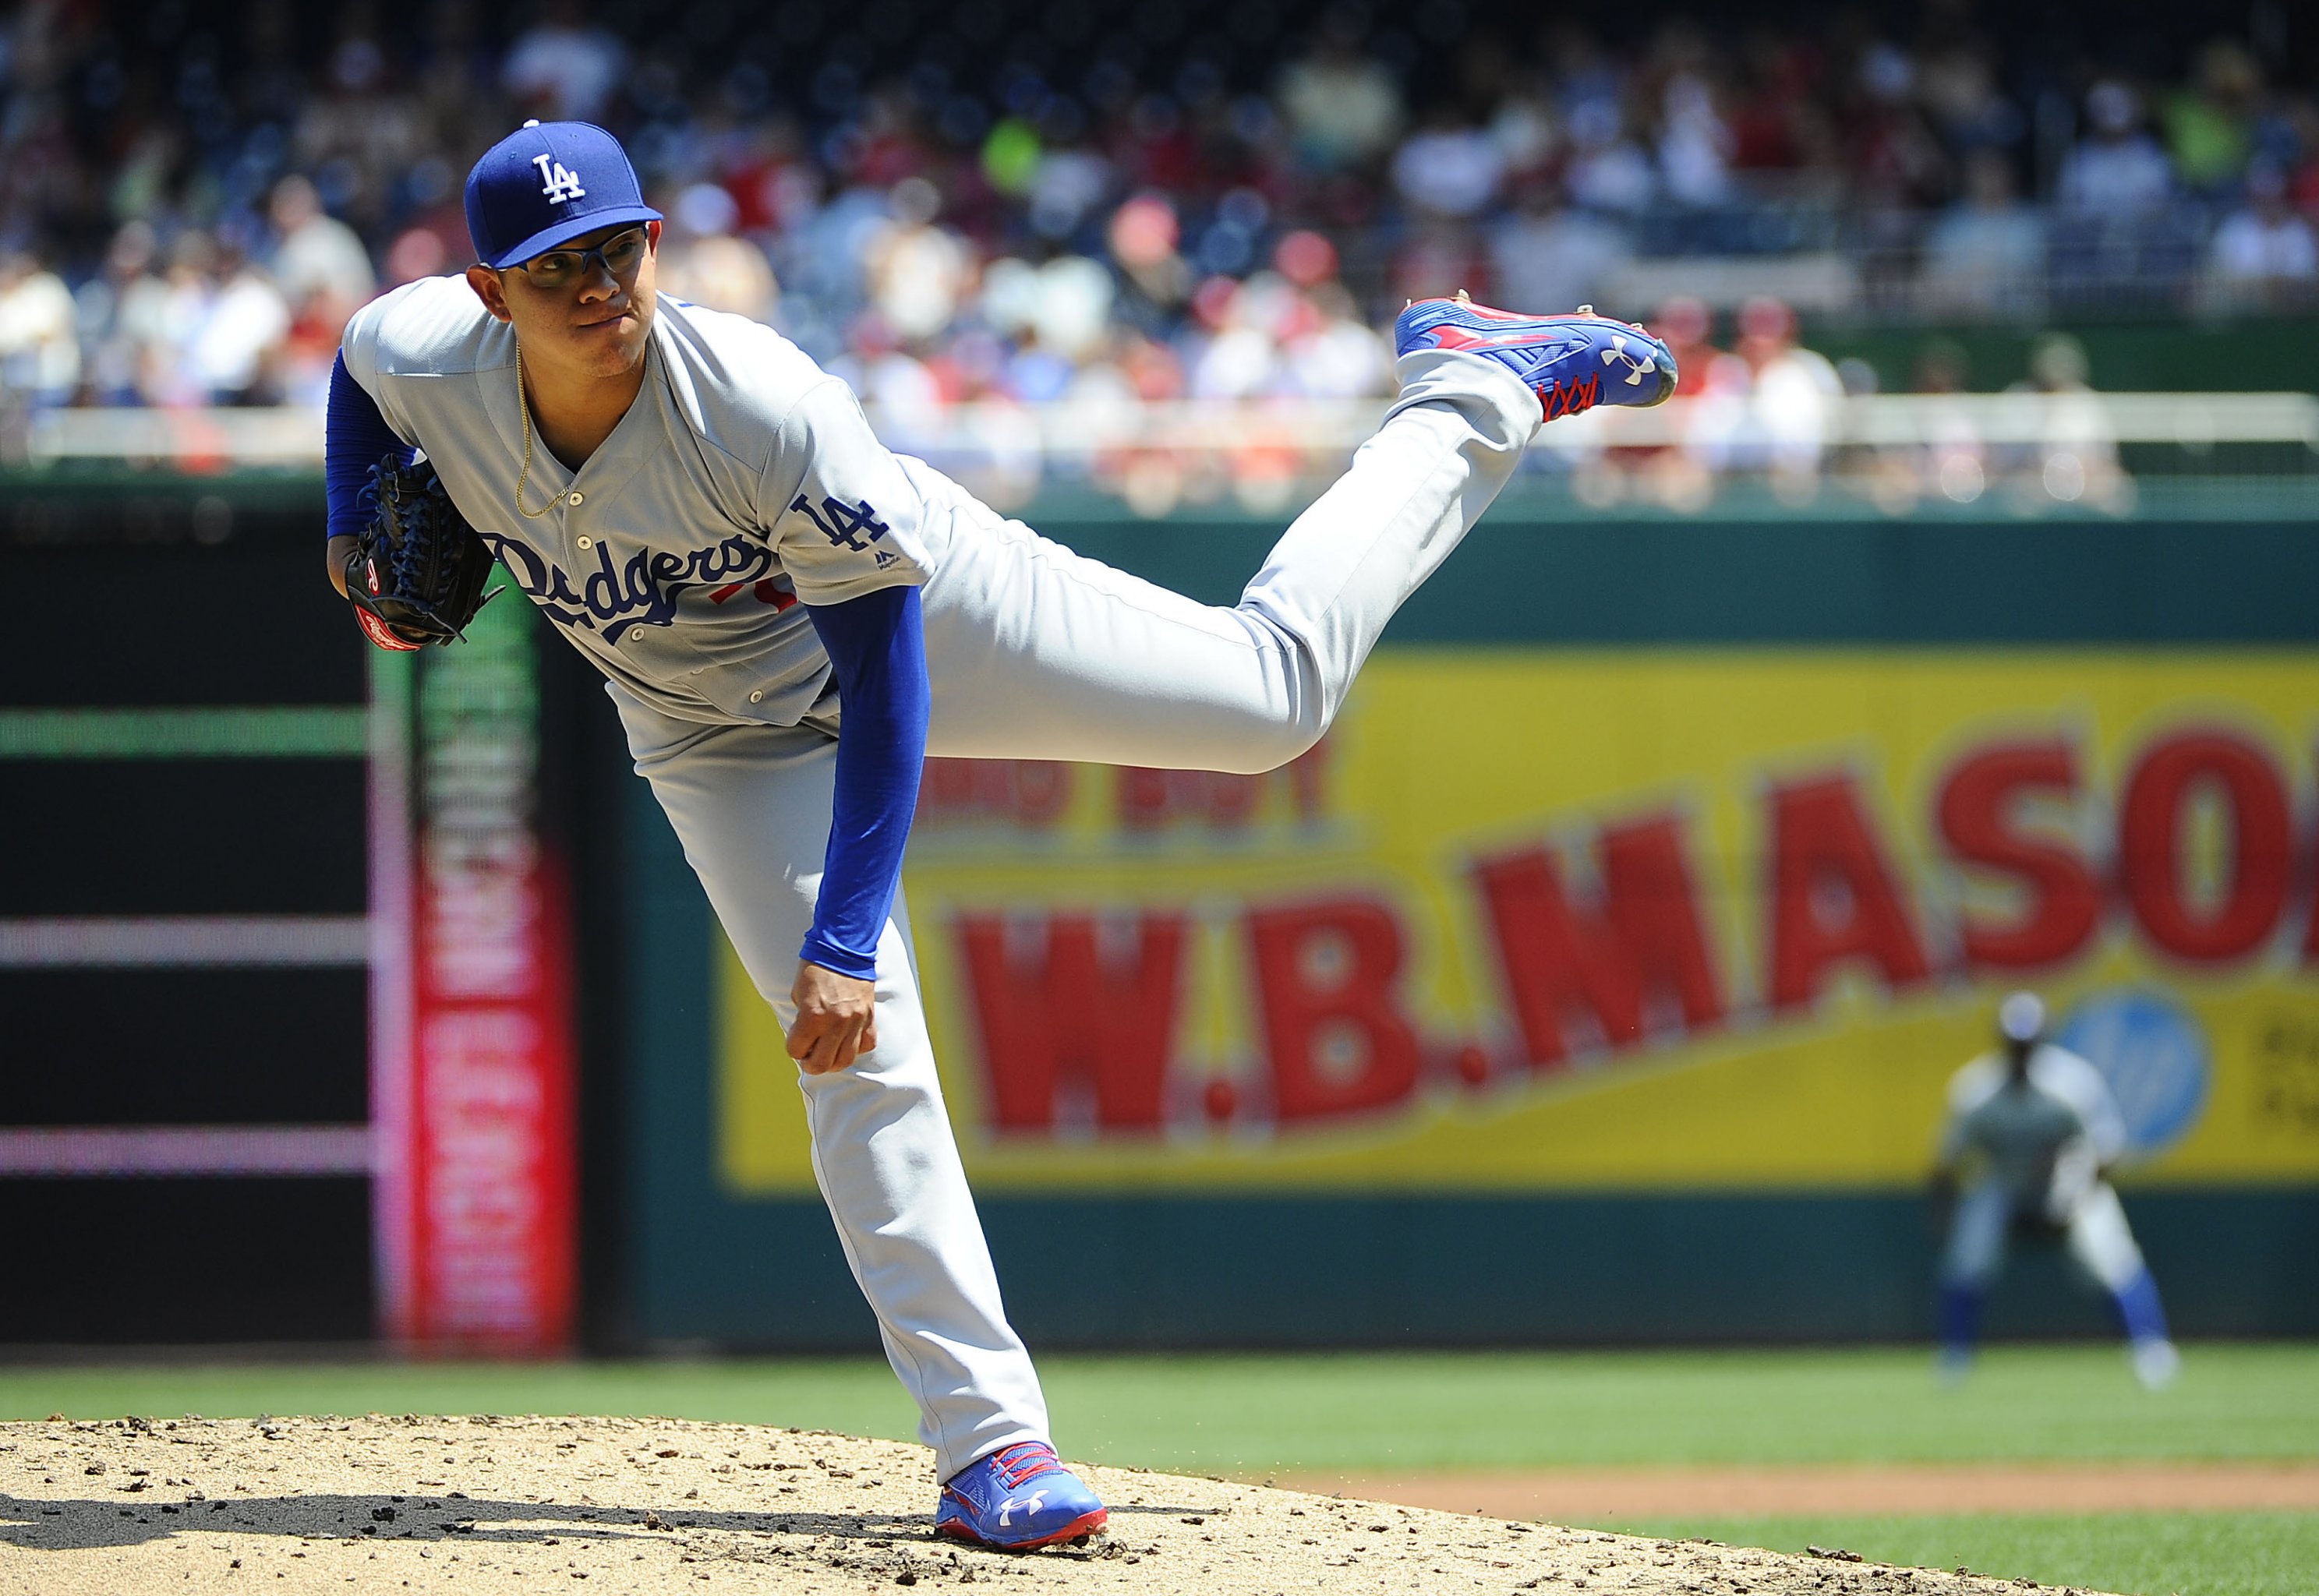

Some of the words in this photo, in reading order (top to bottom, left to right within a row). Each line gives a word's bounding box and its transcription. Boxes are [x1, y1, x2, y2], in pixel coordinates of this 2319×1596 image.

[532, 154, 585, 204] LA
[790, 493, 889, 552] LA
[477, 531, 772, 646] Dodgers
[956, 726, 2319, 1135] W.B.MASO
